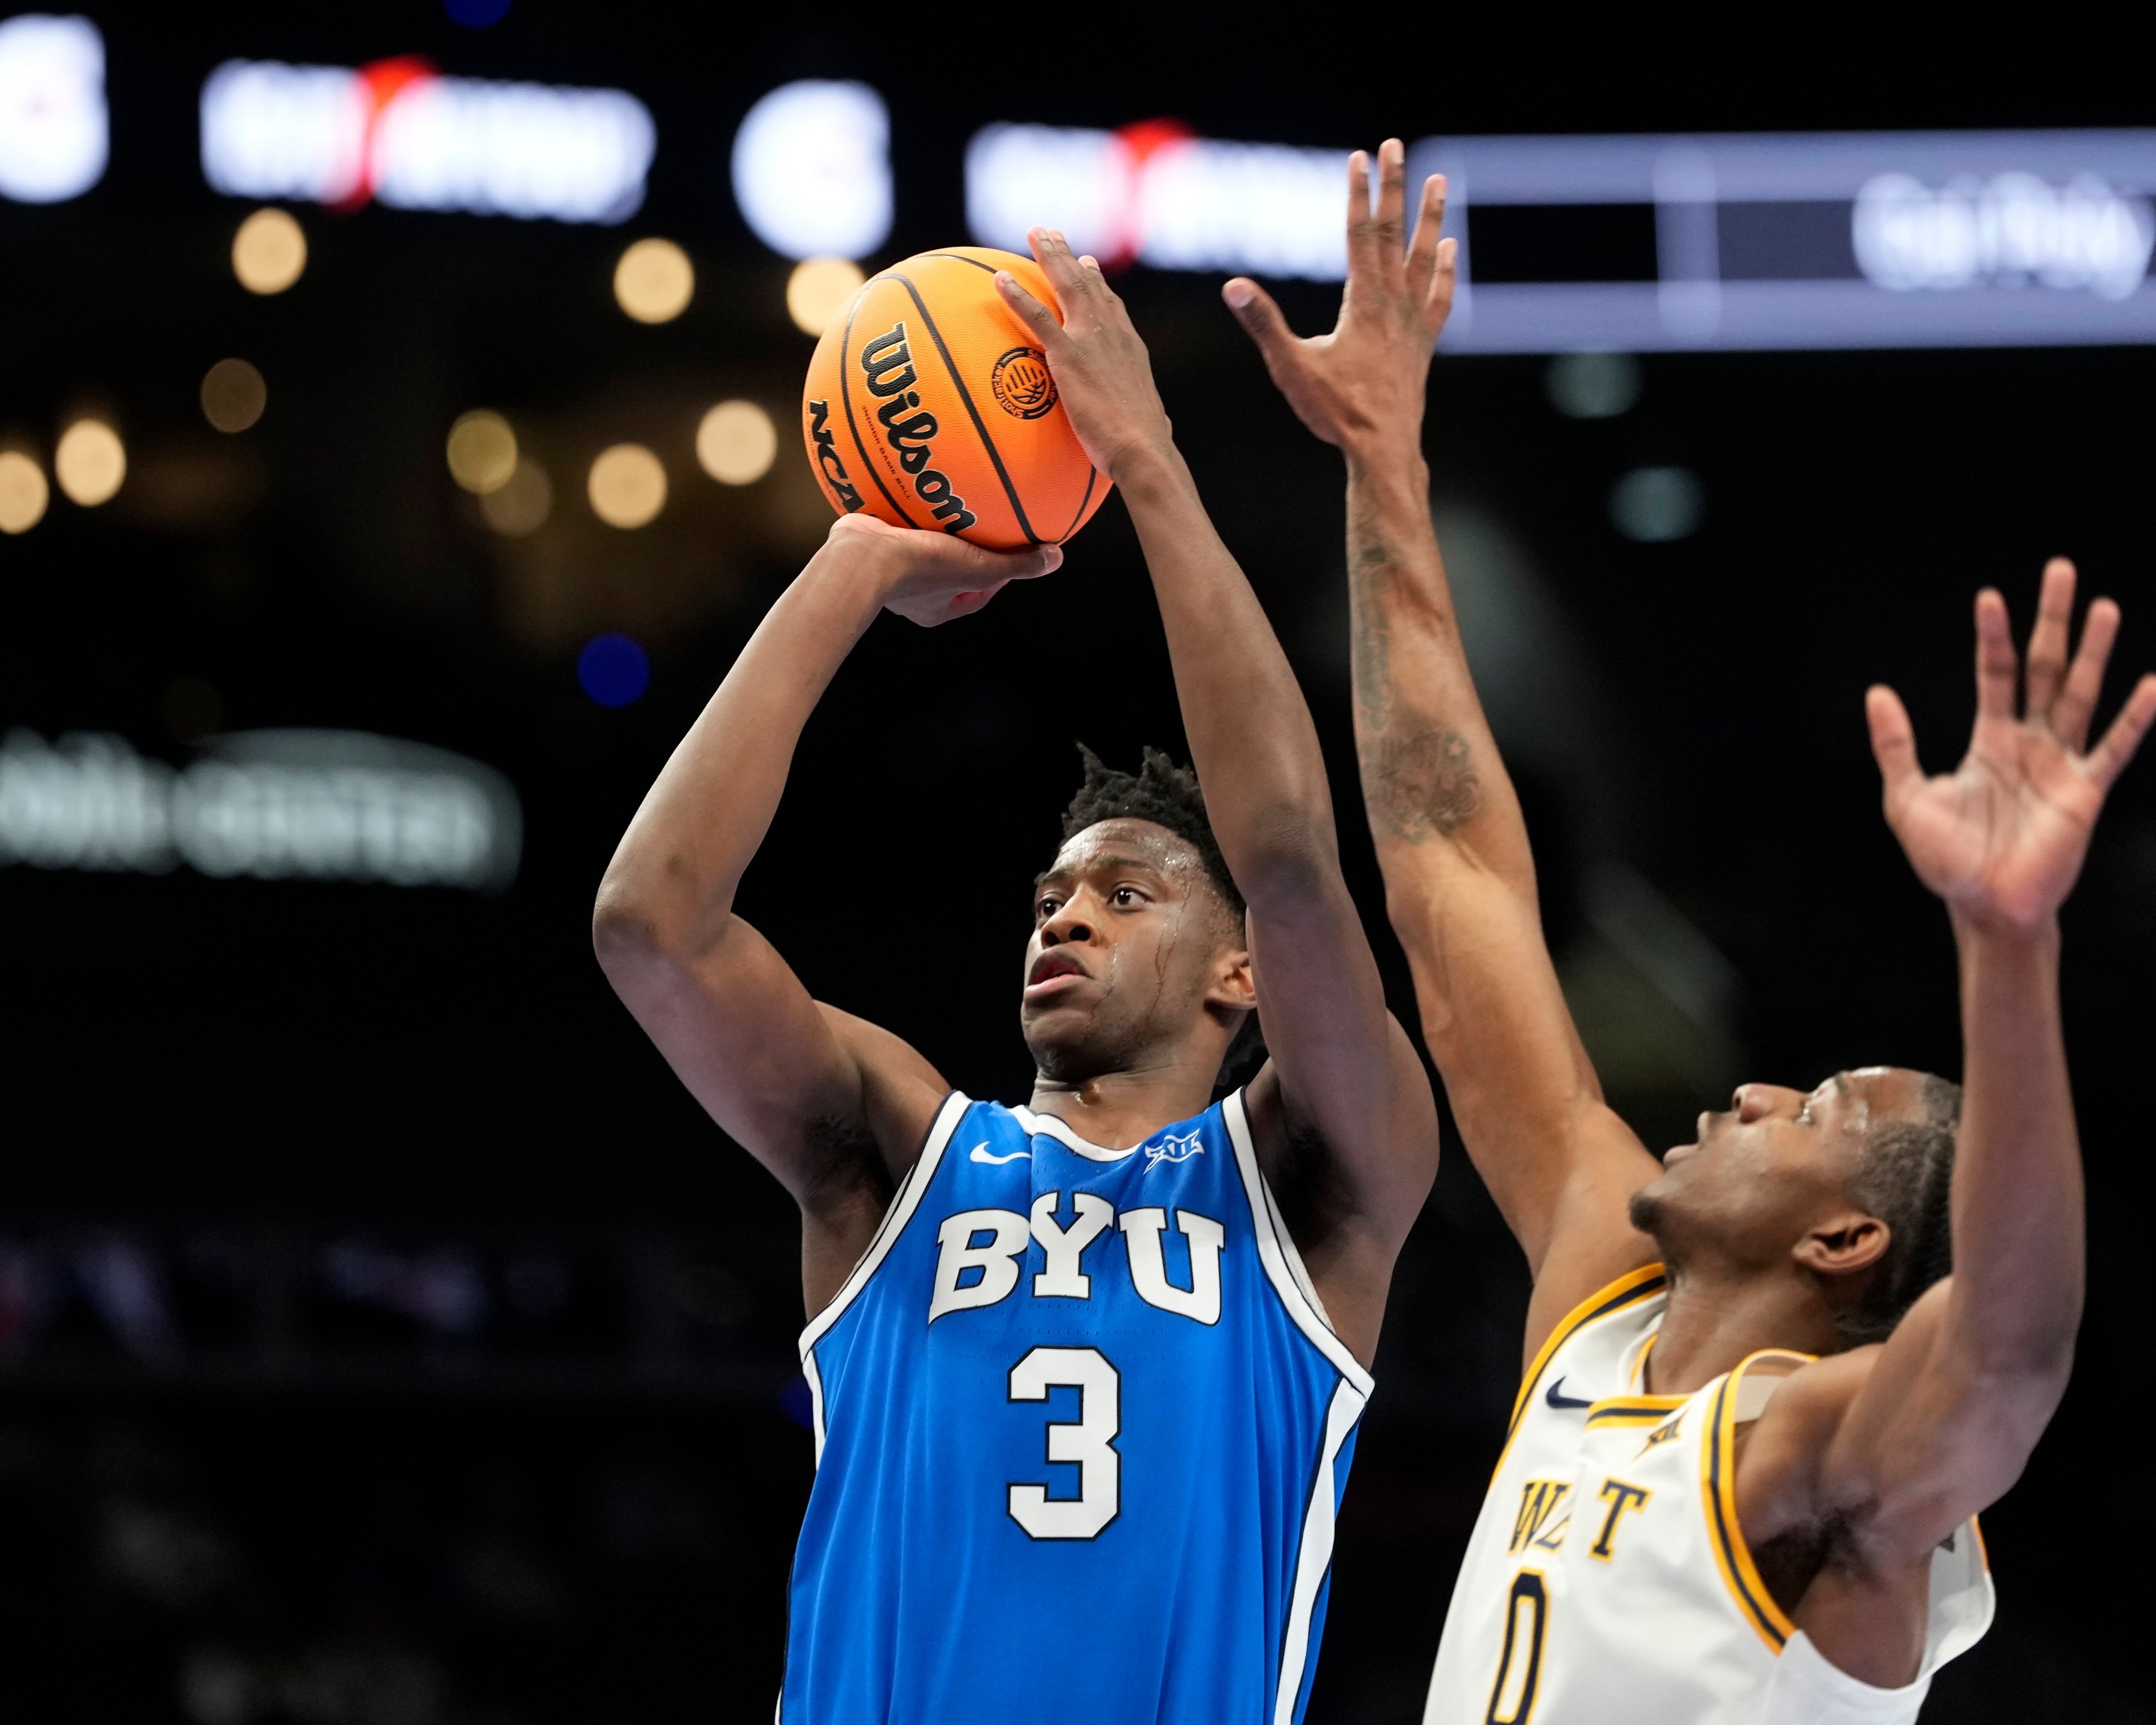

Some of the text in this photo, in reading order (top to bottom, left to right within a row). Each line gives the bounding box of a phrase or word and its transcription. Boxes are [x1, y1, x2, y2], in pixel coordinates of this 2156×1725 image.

[809, 399, 877, 518] NCA
[861, 321, 977, 534] Wilson
[880, 447, 896, 475] GAME
[896, 478, 911, 501] BALL
[928, 1191, 1225, 1326] BYU
[1008, 1346, 1121, 1541] 3
[1484, 1566, 1551, 1725] 0
